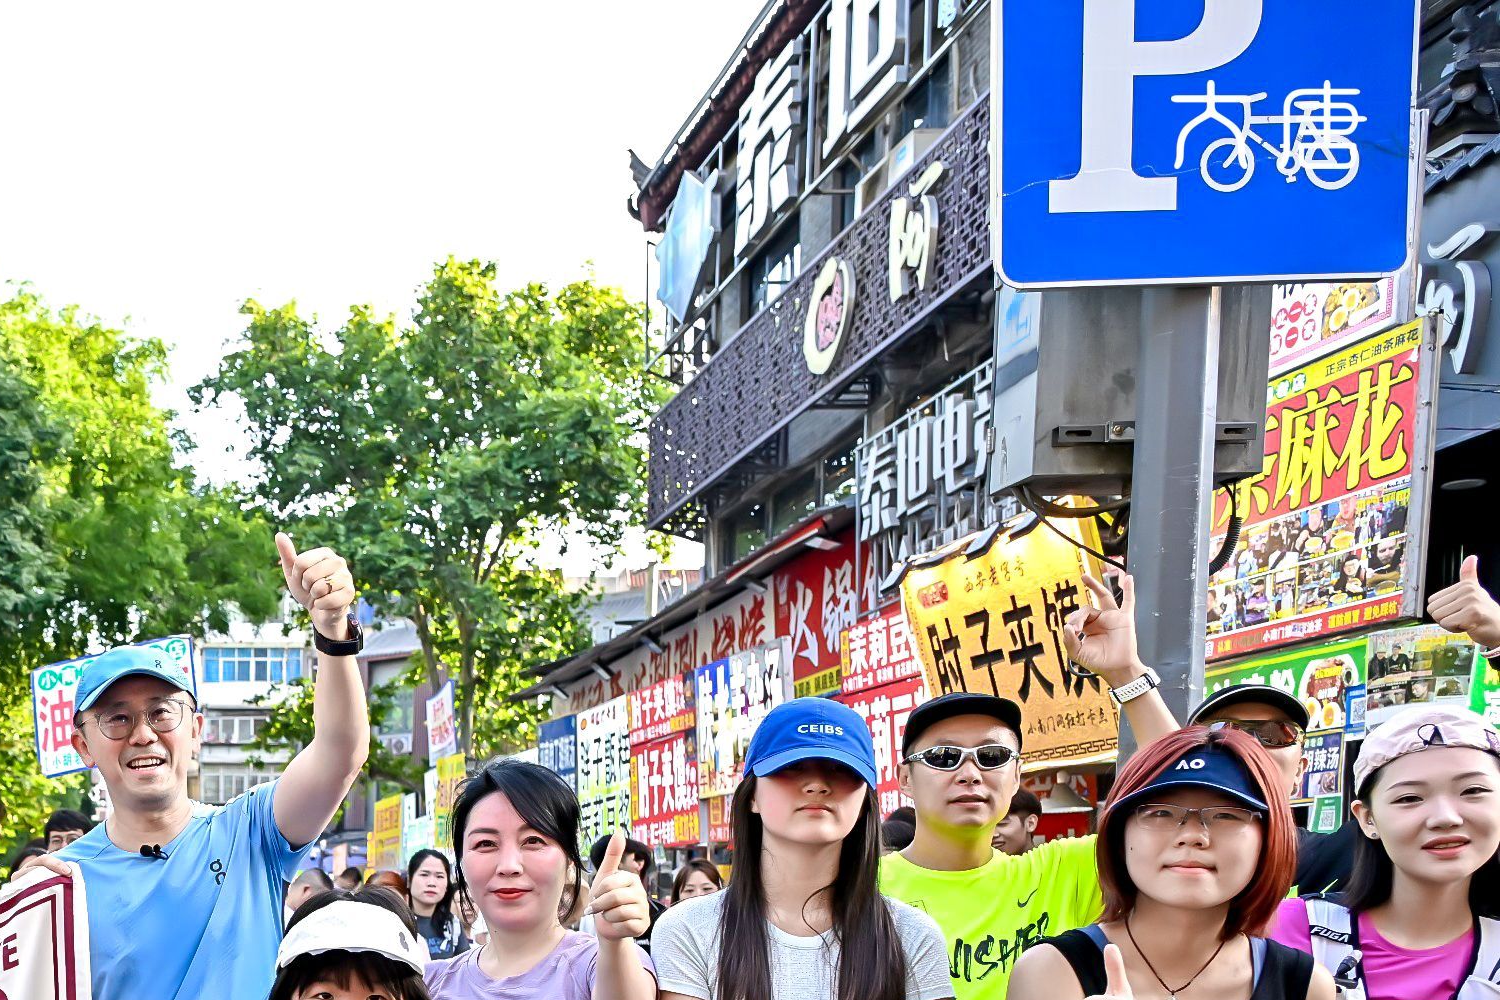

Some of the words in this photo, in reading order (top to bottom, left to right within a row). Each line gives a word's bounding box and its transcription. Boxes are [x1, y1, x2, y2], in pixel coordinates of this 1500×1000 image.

[1048, 0, 1263, 213] P
[848, 614, 914, 675] 茉莉豆
[39, 689, 75, 752] 油
[797, 724, 844, 736] CEIBS
[1310, 925, 1350, 943] FUGA
